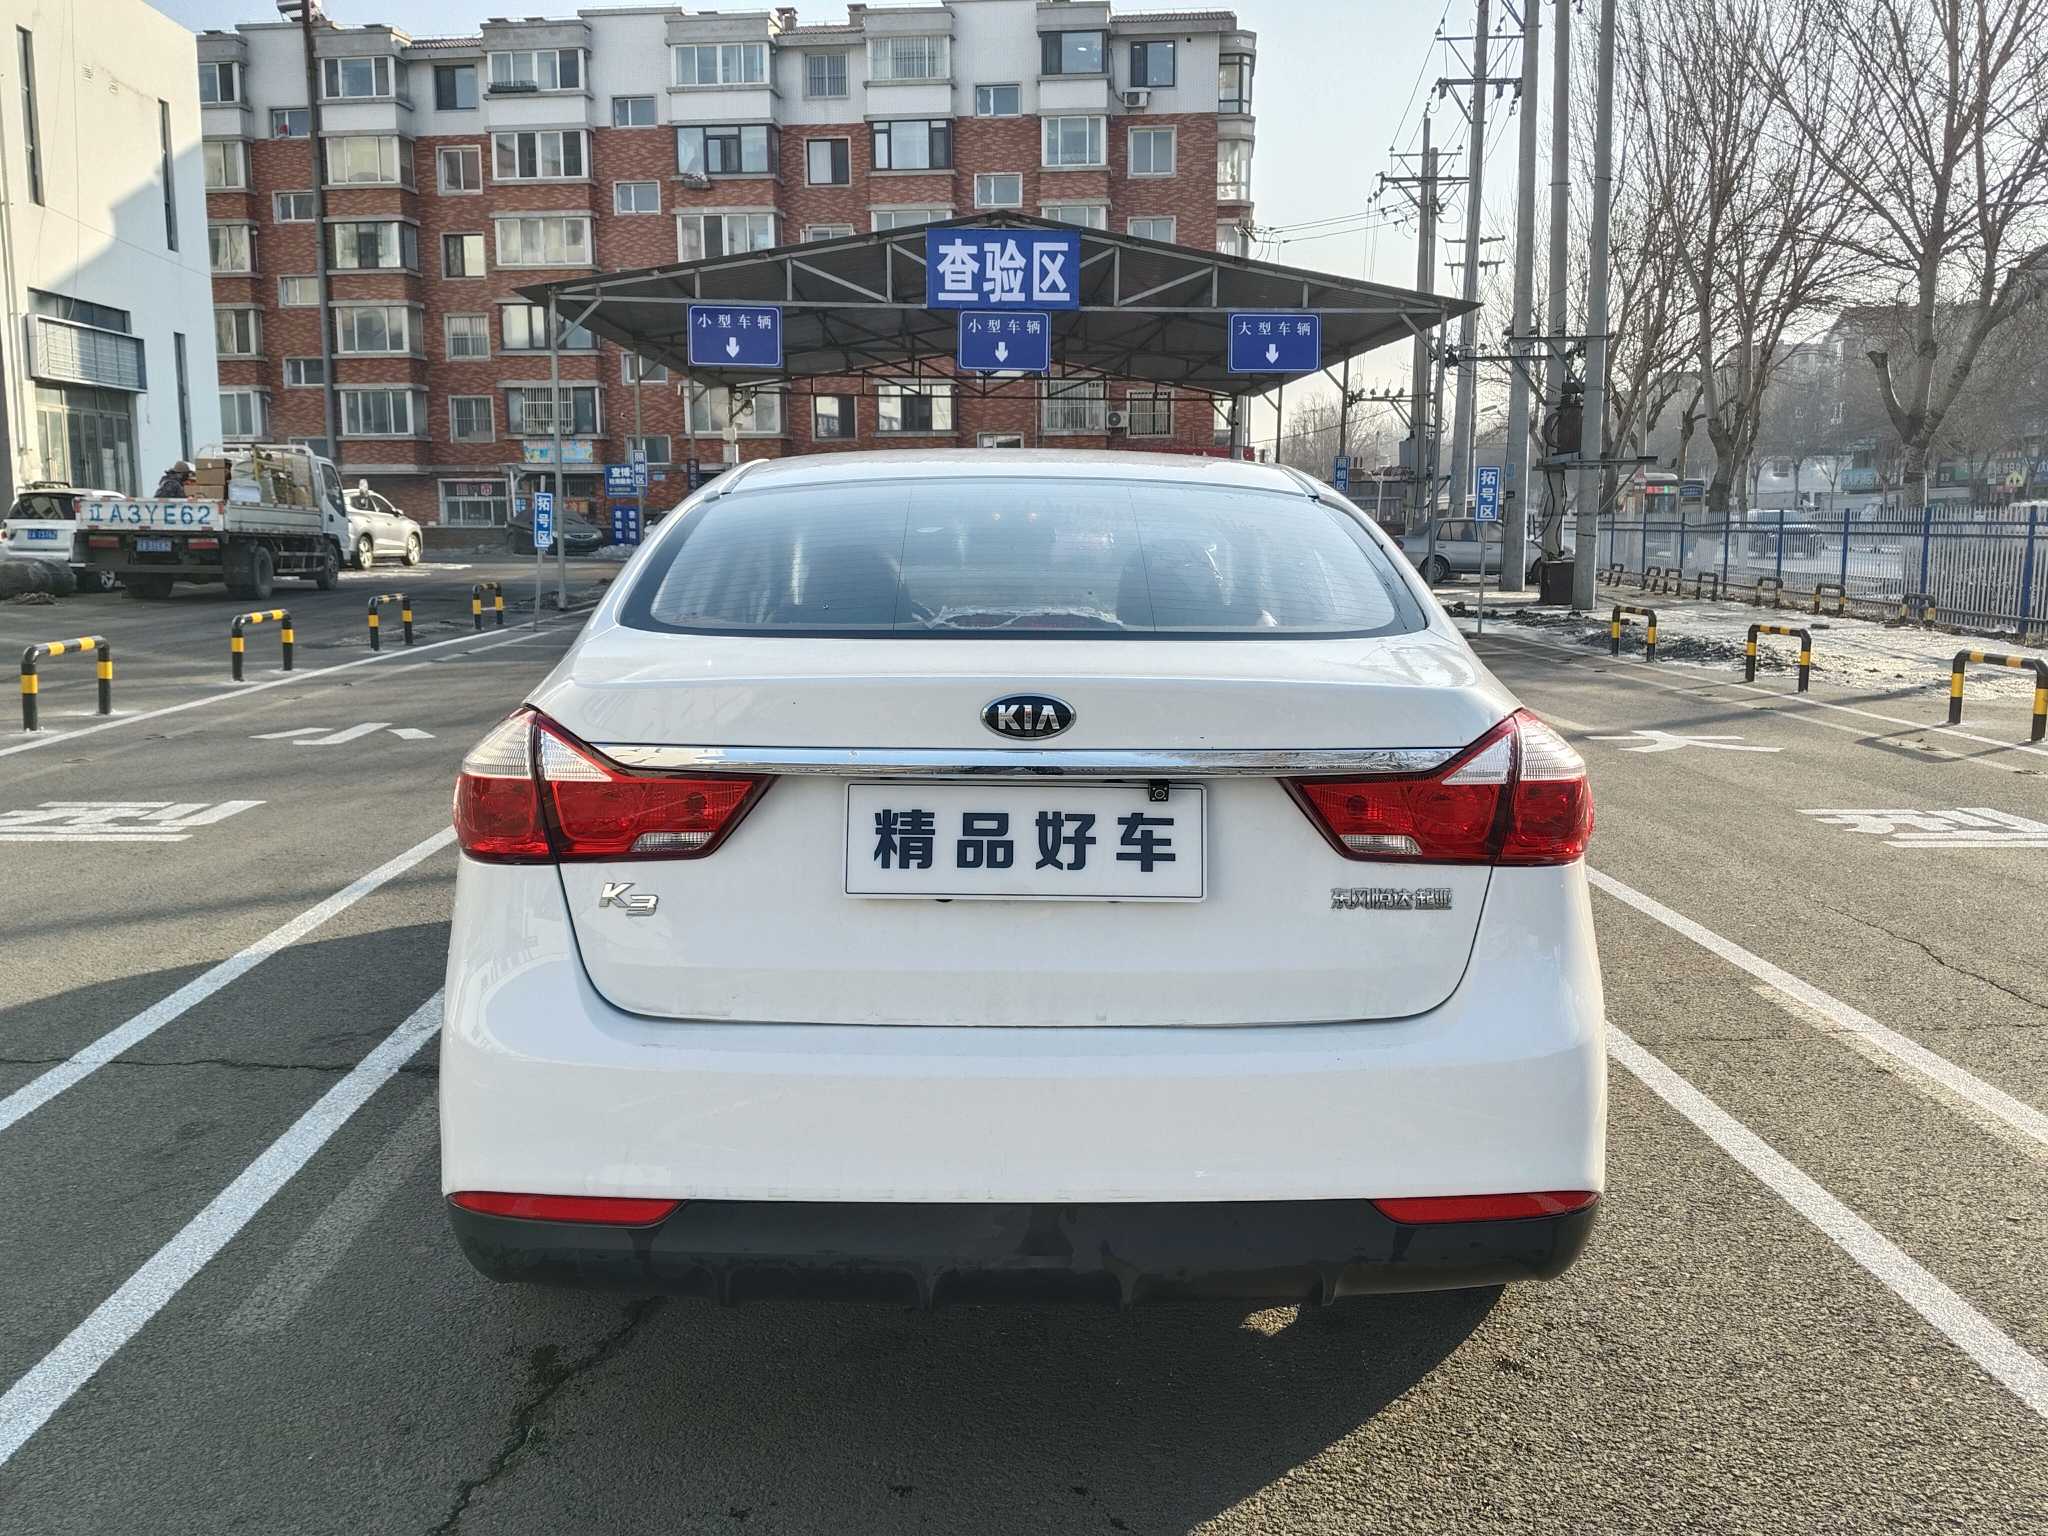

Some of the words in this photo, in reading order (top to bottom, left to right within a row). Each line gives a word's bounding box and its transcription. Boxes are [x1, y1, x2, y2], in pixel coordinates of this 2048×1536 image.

[937, 239, 1069, 302] 查验区
[697, 313, 771, 329] 小型车辆
[968, 318, 1040, 334] 小型车辆
[1239, 321, 1311, 336] 大型车辆
[1480, 470, 1497, 518] 拓号区
[537, 496, 550, 544] 拓号区
[997, 704, 1060, 730] KIA
[874, 807, 1177, 872] 精品好车
[599, 882, 659, 916] K3
